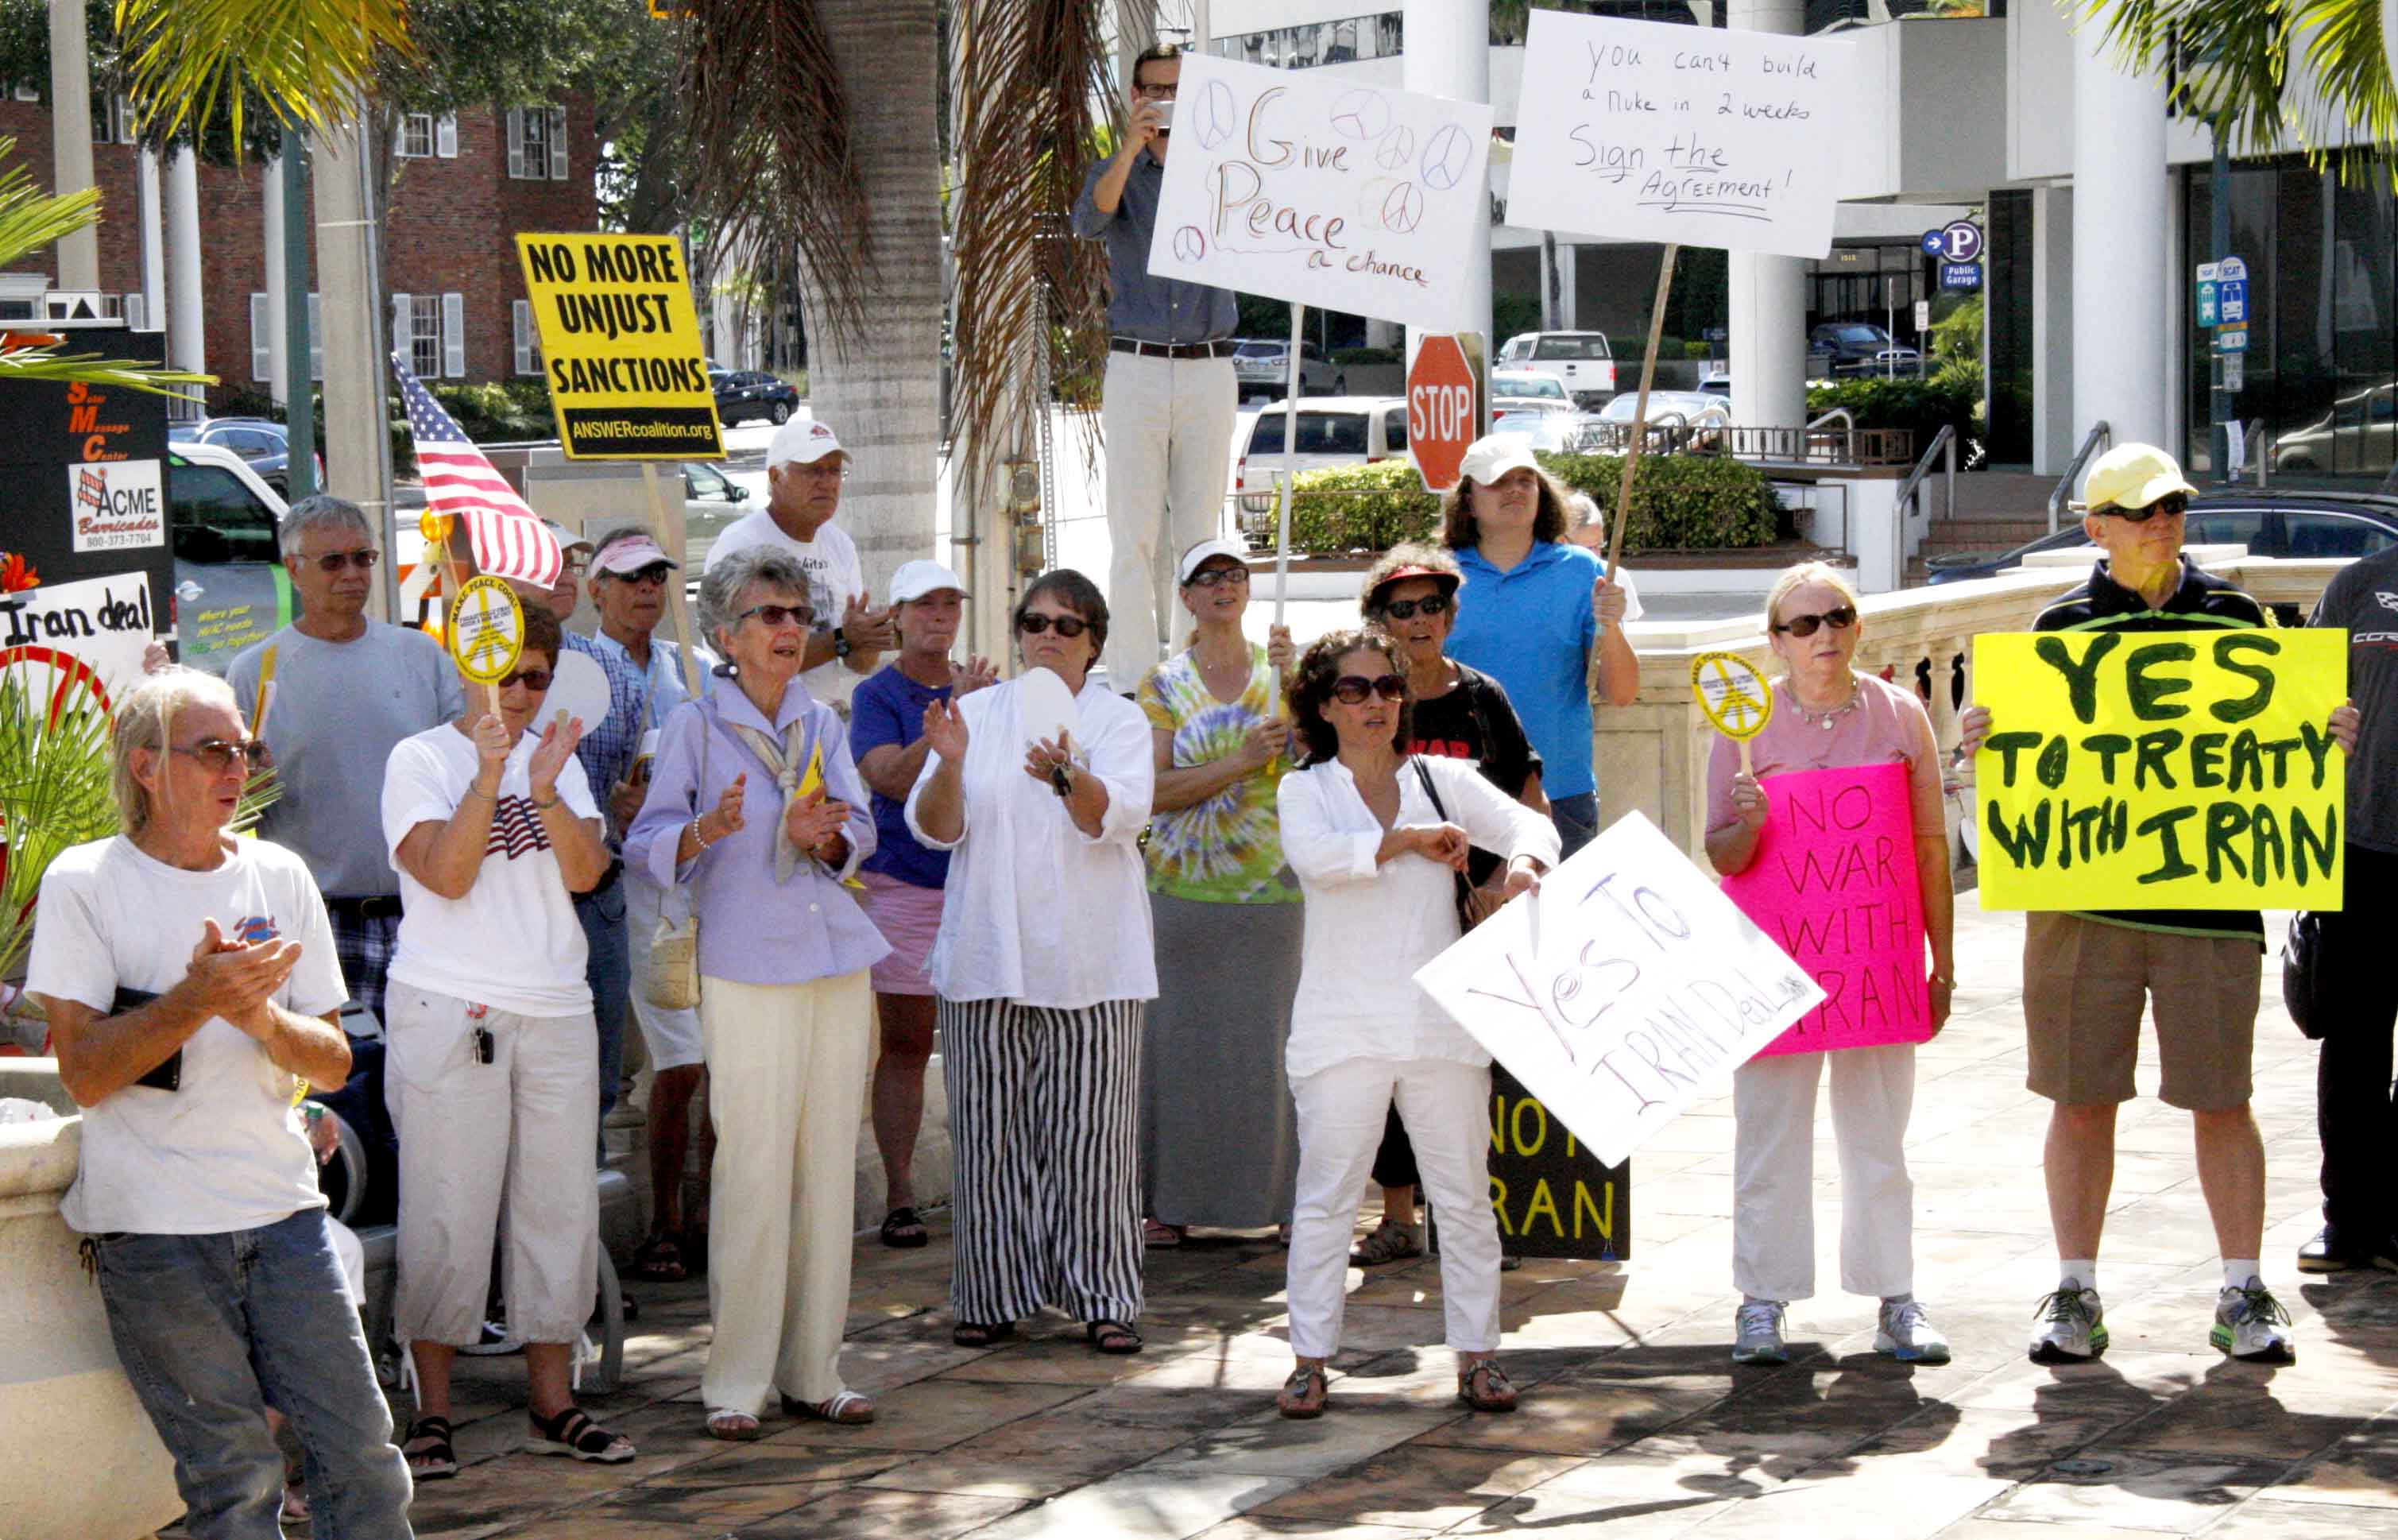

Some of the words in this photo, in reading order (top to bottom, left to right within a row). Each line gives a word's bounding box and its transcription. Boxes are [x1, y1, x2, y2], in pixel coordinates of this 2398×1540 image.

[1763, 52, 1816, 79] build
[1247, 85, 1349, 171] Give
[1582, 88, 1594, 99] a
[1673, 99, 1689, 111] in
[1717, 92, 1732, 114] 2
[1742, 101, 1810, 120] weeks
[1569, 123, 1643, 183] Sign
[1665, 132, 1729, 167] the
[1216, 160, 1348, 250] Peace
[527, 243, 577, 283] NO
[583, 243, 679, 283] MORE
[1947, 229, 1974, 256] P
[1307, 250, 1332, 269] a
[1346, 250, 1430, 287] chance
[1945, 275, 1978, 285] Garage
[1948, 266, 1975, 275] Public
[555, 293, 672, 341] UNJUST
[551, 358, 706, 394] SANCTIONS
[572, 420, 713, 440] ANSWERcoalition.org
[1411, 384, 1471, 443] STOP
[96, 478, 157, 517] ACME
[78, 515, 160, 535] Barricades
[469, 579, 496, 594] PEACE
[0, 601, 95, 647] Iran
[97, 582, 149, 632] deal
[2035, 632, 2281, 725] YES
[1986, 731, 2069, 790] TO
[2080, 720, 2335, 793] TREATY
[1789, 785, 1872, 835] NO
[1779, 836, 1899, 896] WAR
[1987, 796, 2128, 869] WITH
[2135, 801, 2337, 888] IRAN
[1779, 902, 1910, 958] WITH
[1796, 959, 1920, 1035] RAN
[1590, 993, 1729, 1116] IRAN
[1488, 1176, 1615, 1239] RAN
